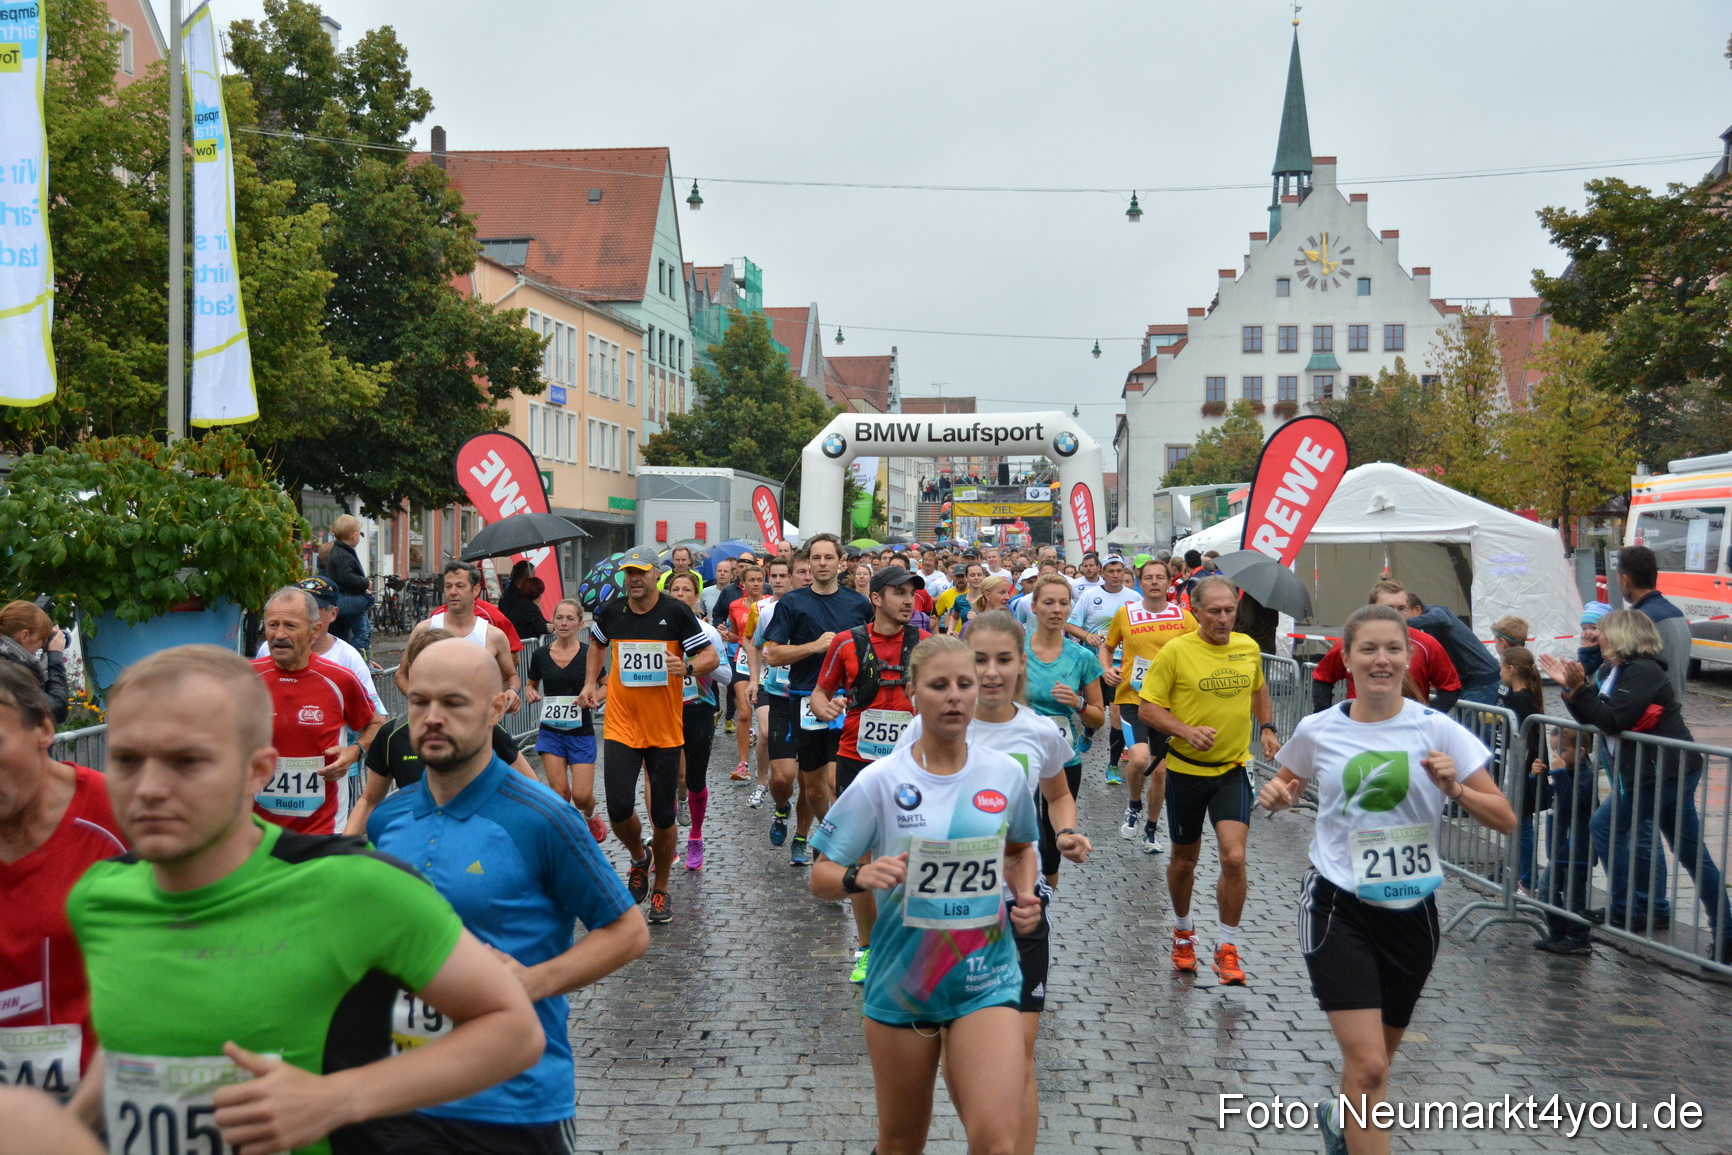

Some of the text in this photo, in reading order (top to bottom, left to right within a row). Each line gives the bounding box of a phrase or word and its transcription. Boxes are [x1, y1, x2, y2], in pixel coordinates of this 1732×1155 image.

[856, 422, 1044, 446] BMW Laufsport
[1252, 436, 1334, 561] REWE
[992, 505, 1015, 514] ZIEL
[1130, 622, 1185, 635] MAX BÖGL
[623, 653, 663, 669] 2810
[1135, 667, 1148, 680] 2
[545, 705, 578, 719] 2875
[263, 772, 320, 793] 2414
[276, 799, 305, 809] Rudolf
[897, 814, 926, 823] PARTL
[1391, 826, 1428, 838] BOCK
[957, 839, 998, 853] BOCK
[1363, 843, 1432, 878] 2135
[918, 858, 997, 893] 2725
[1384, 884, 1421, 898] Carina
[944, 902, 970, 916] Lisa
[966, 955, 987, 972] 17.
[1, 1030, 67, 1048] BOCK
[0, 1057, 71, 1093] 44
[119, 1100, 242, 1155] 205
